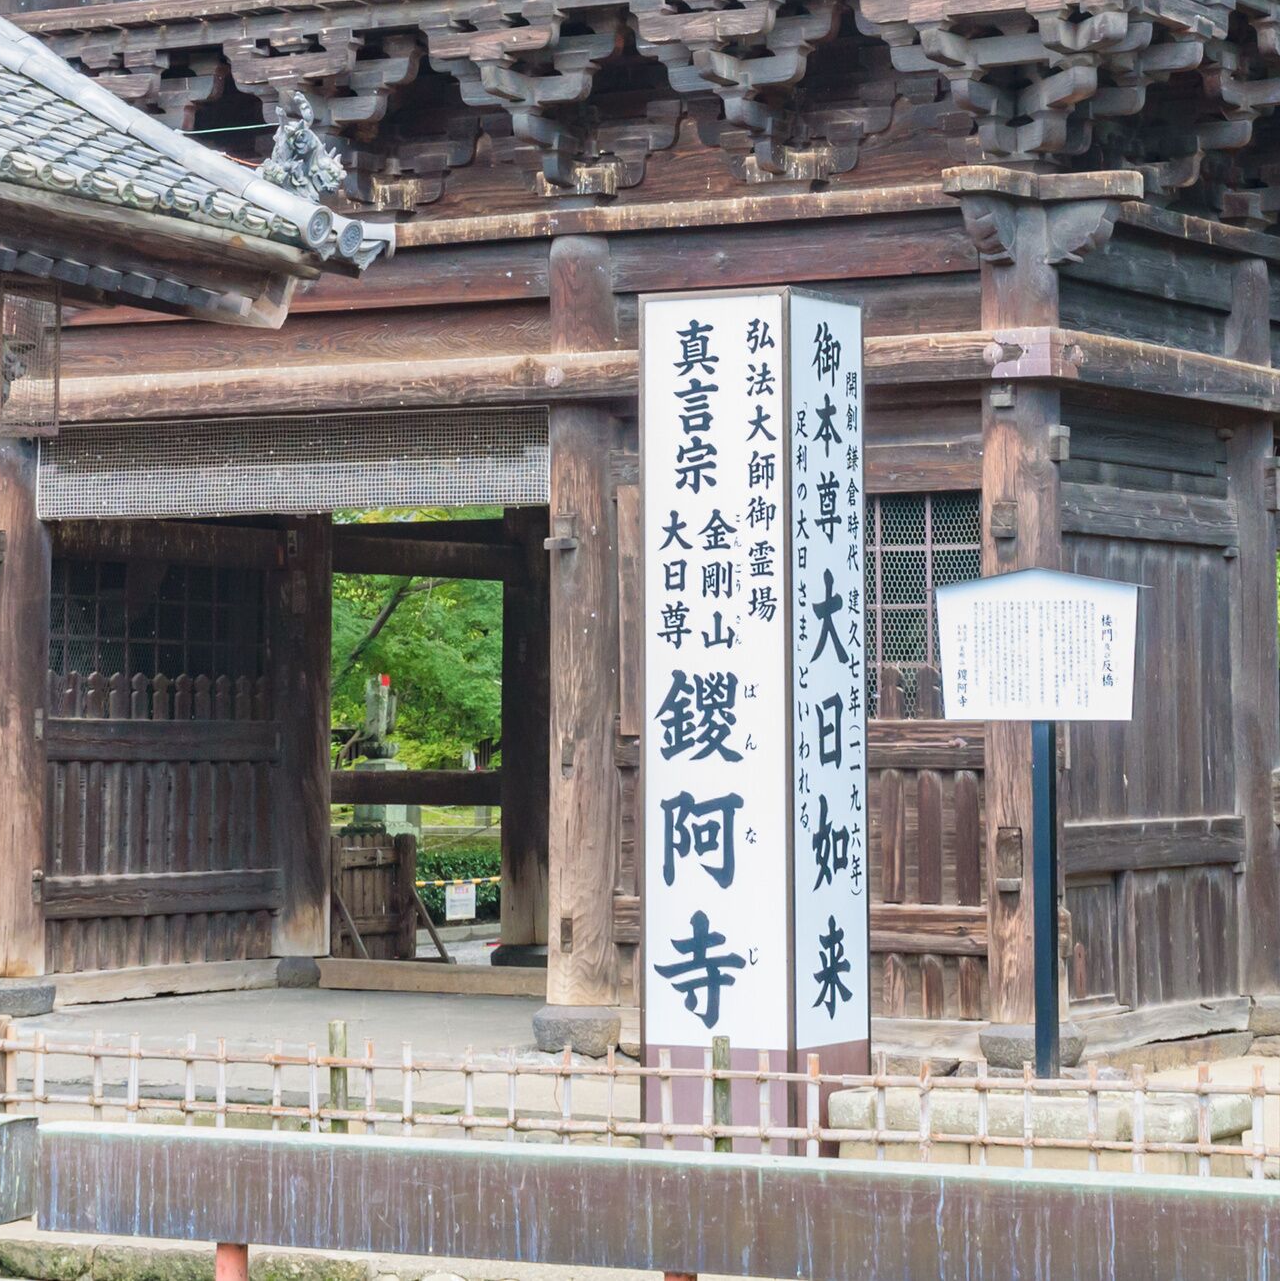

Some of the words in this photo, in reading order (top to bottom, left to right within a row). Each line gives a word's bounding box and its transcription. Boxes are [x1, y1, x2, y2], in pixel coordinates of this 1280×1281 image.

[673, 319, 720, 494] 真言宗
[746, 318, 778, 622] 弘法大師御霊場
[656, 510, 694, 650] 大日尊
[698, 509, 737, 649] 金剛山
[810, 322, 853, 1020] 御本尊大日如来
[654, 670, 747, 1029] 鑁阿寺
